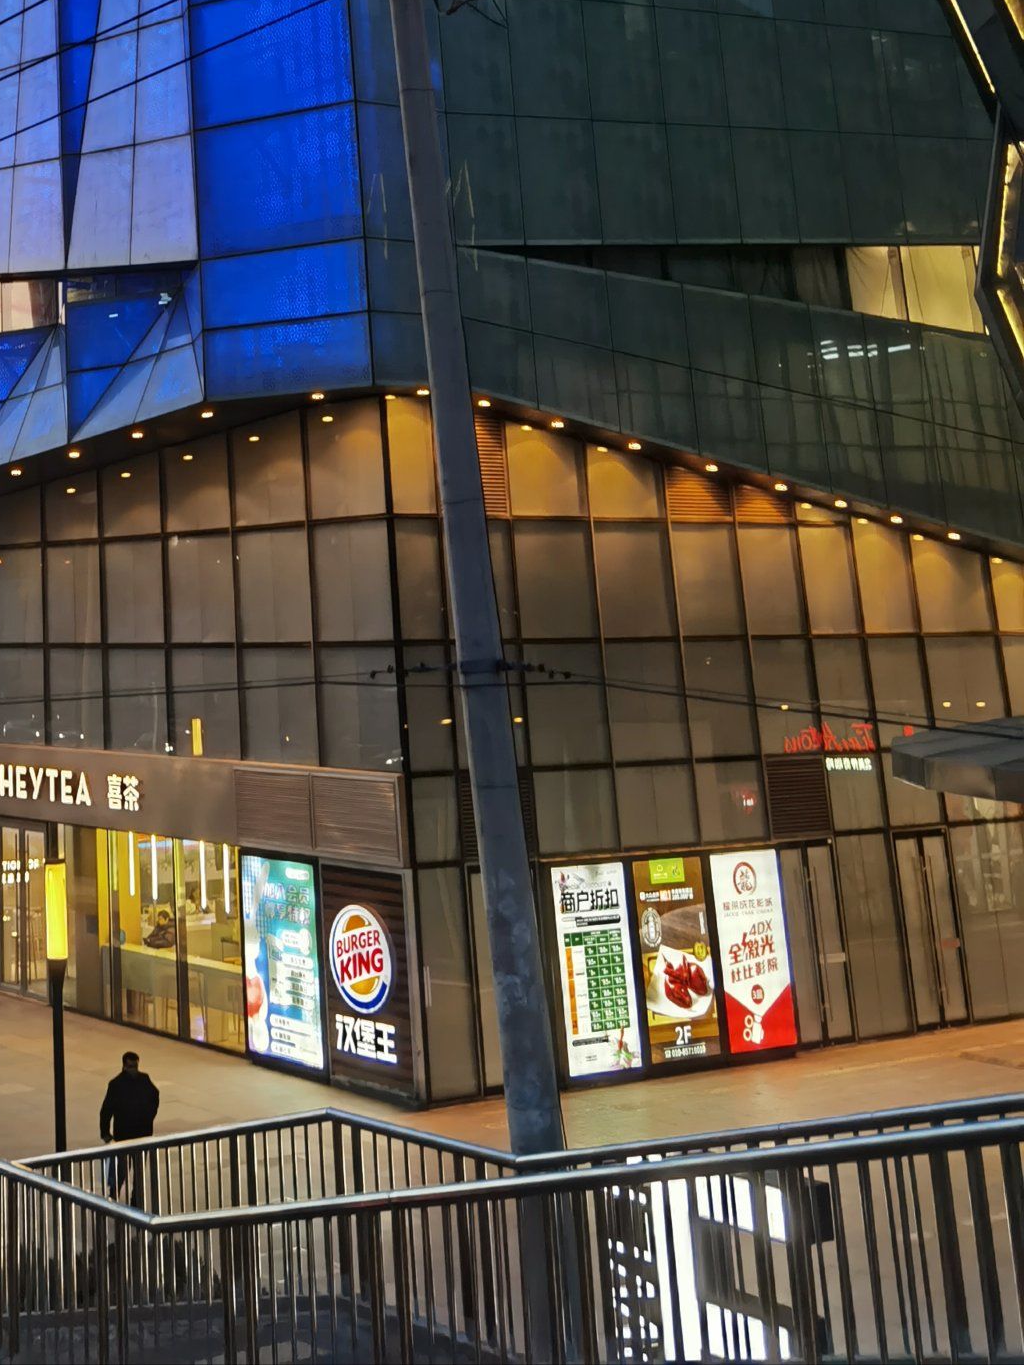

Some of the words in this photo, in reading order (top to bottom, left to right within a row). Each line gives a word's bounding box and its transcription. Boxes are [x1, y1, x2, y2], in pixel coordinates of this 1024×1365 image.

[0, 763, 92, 806] HEYTEA
[107, 773, 140, 811] 喜茶
[560, 888, 619, 914] 商户折扣
[749, 919, 773, 936] 4DX
[336, 930, 381, 959] BURGER
[729, 933, 775, 966] 全激光
[339, 947, 384, 984] KING
[731, 957, 778, 984] 杜比影院
[335, 1013, 397, 1064] 汉堡王
[675, 1025, 692, 1045] 2F
